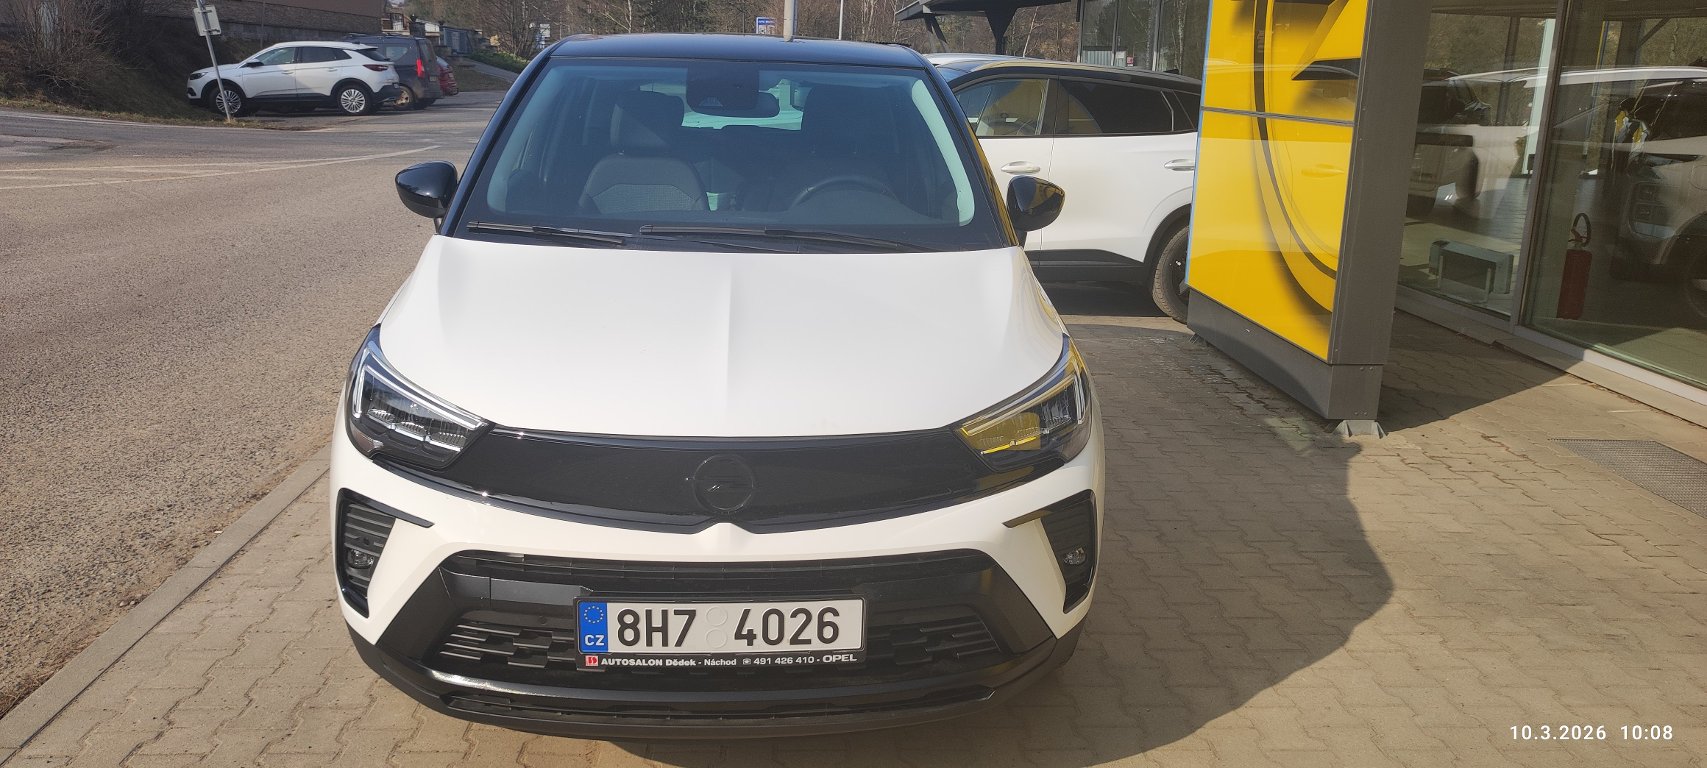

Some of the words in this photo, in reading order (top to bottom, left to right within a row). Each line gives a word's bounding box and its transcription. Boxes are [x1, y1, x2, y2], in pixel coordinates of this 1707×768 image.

[617, 608, 697, 648] 8H7
[734, 606, 840, 647] 4026
[584, 634, 605, 646] CZ
[601, 658, 663, 666] AUTOSALON
[666, 658, 697, 666] Dědek
[704, 657, 737, 666] Náchod
[753, 657, 771, 665] 491
[774, 656, 793, 664] 426
[795, 656, 815, 664] 410
[822, 653, 858, 663] OPEL
